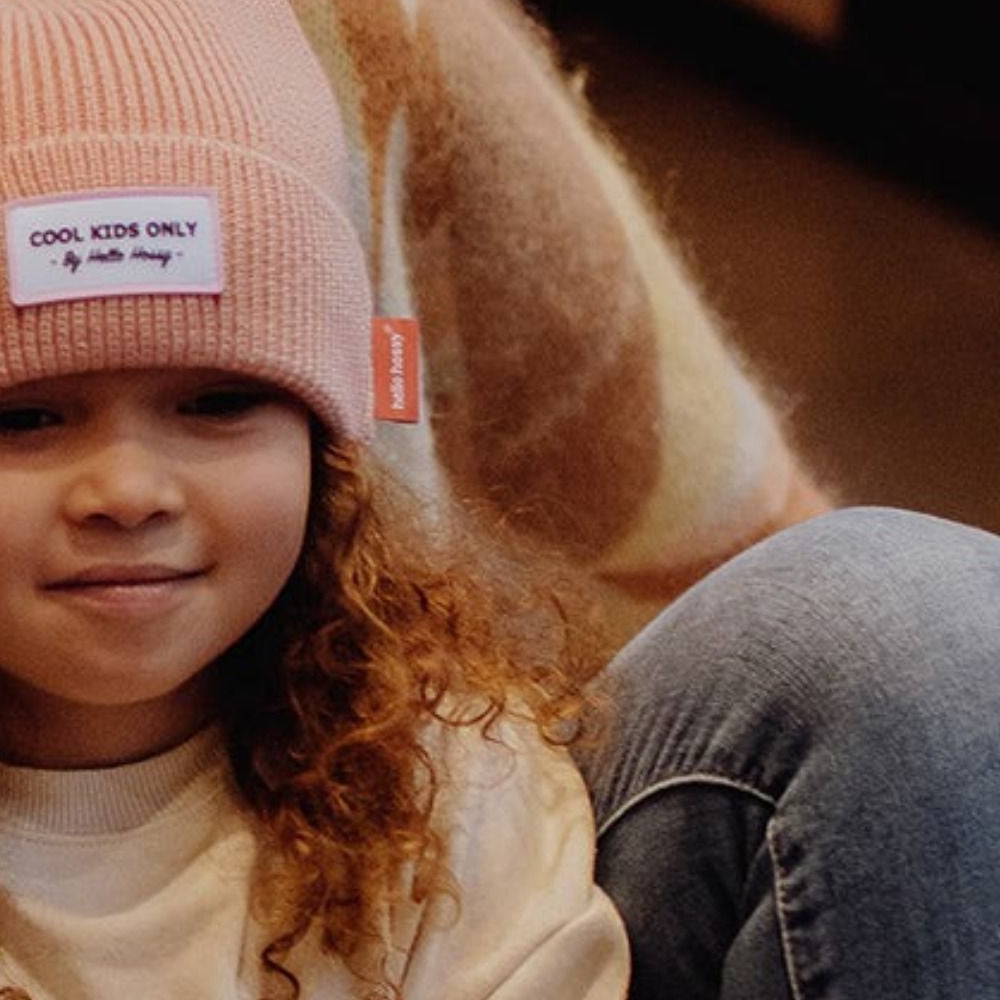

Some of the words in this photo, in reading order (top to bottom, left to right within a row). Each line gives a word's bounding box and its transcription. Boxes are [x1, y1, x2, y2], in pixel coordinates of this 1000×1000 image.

[29, 228, 84, 247] COOL
[90, 222, 140, 240] KIDS
[146, 221, 198, 238] ONLY
